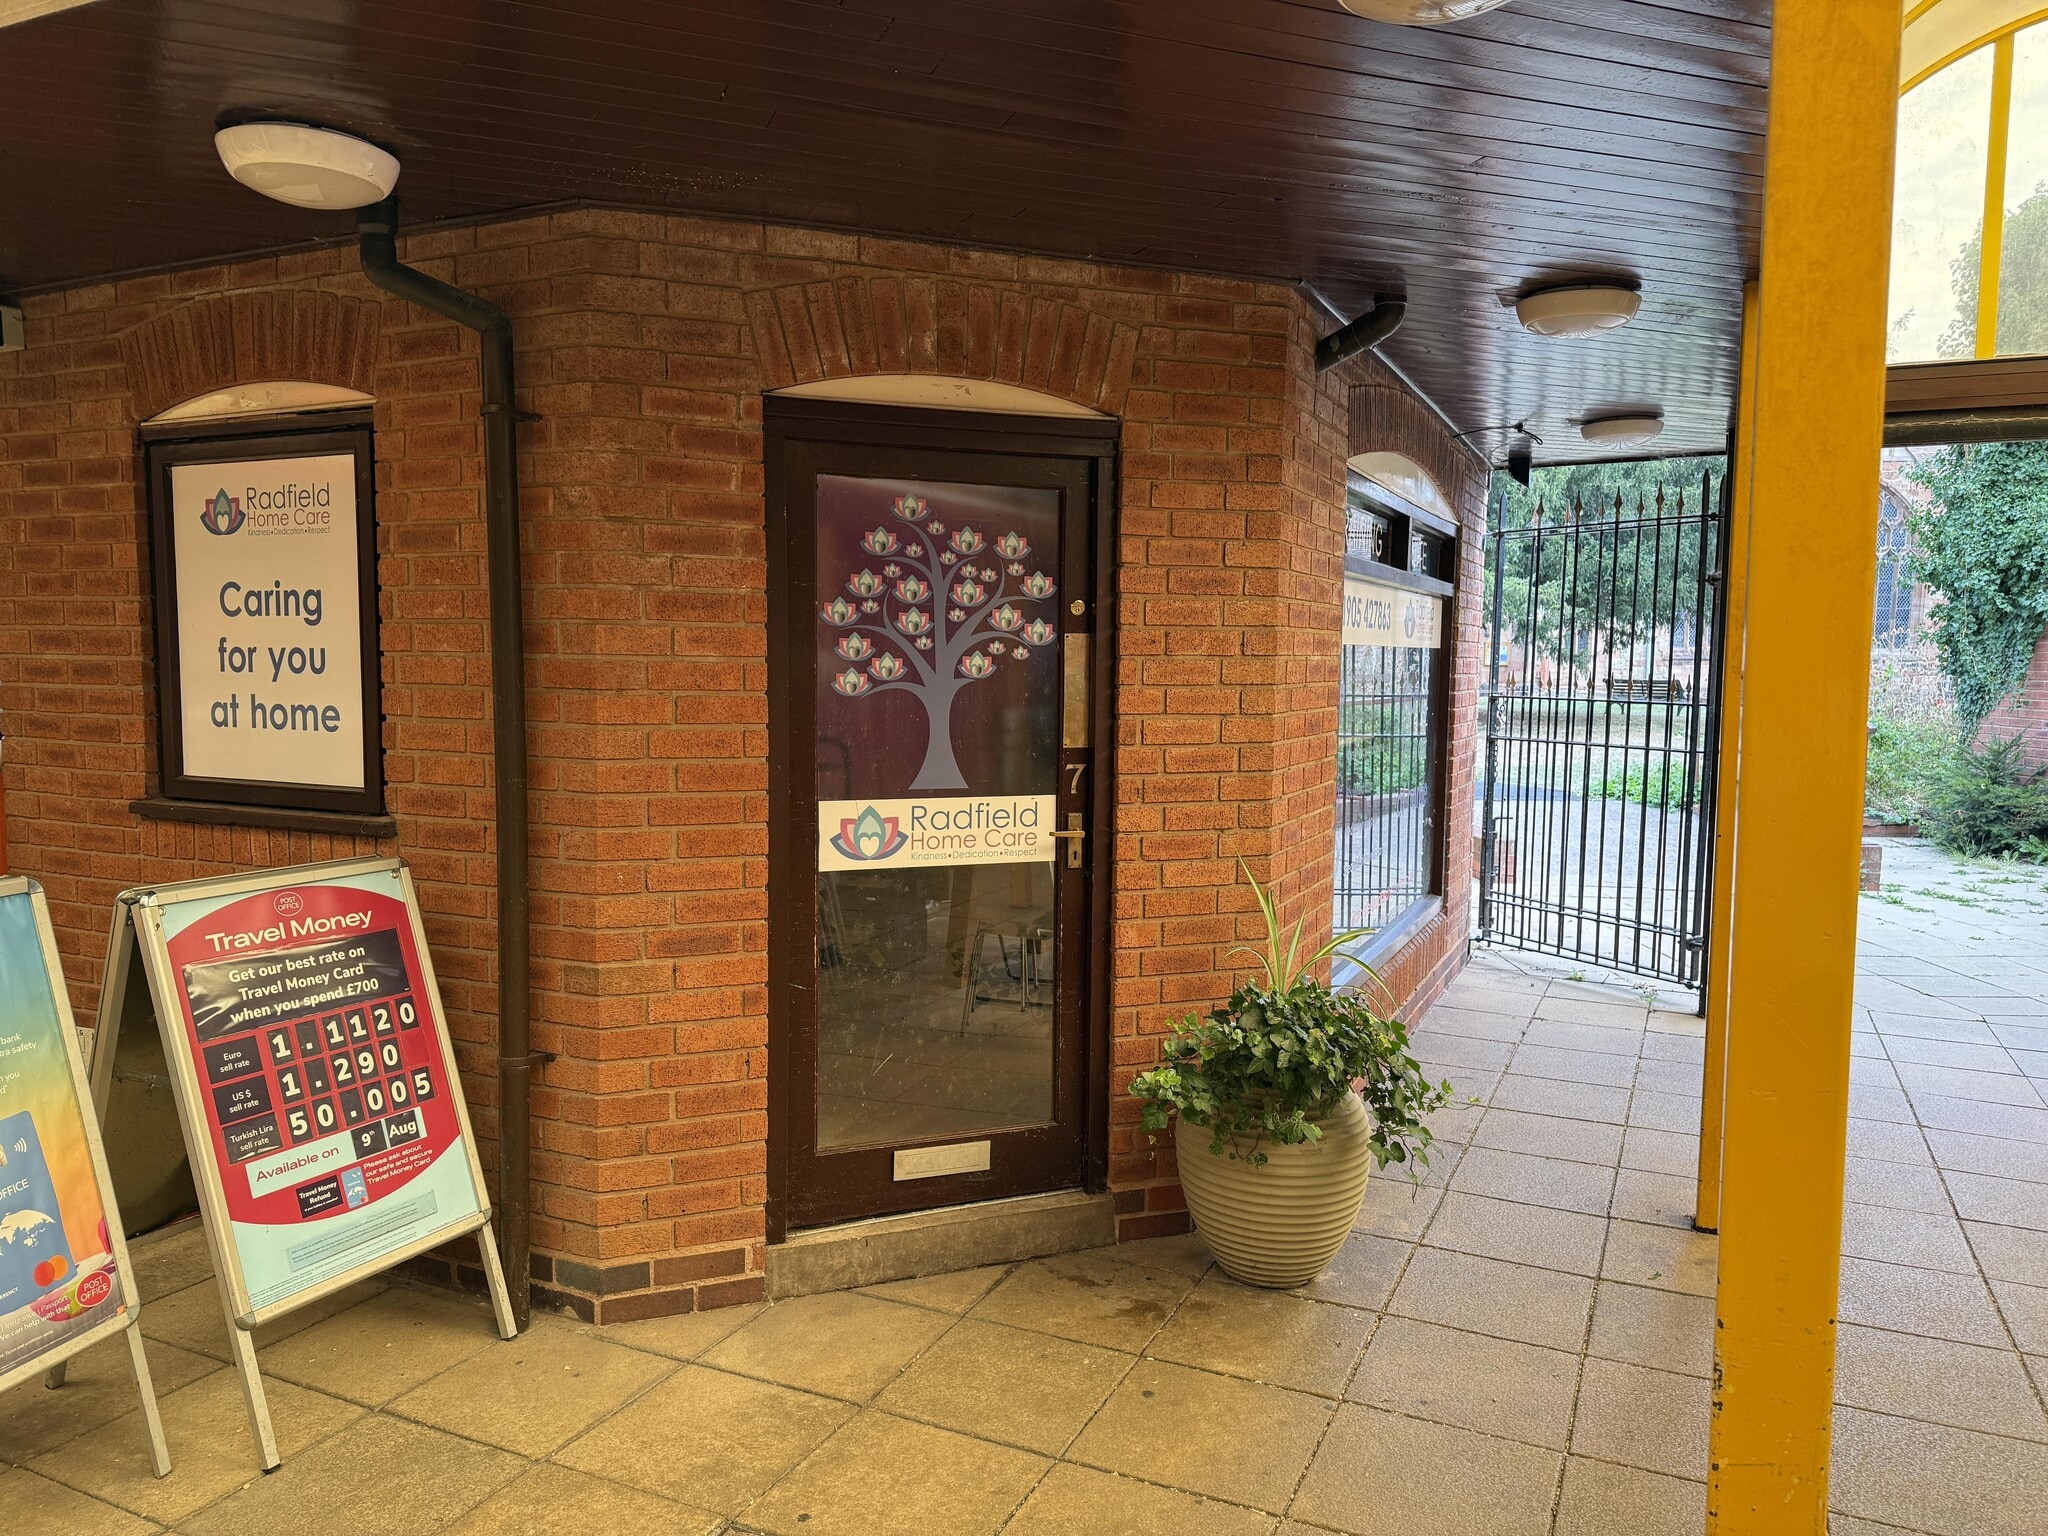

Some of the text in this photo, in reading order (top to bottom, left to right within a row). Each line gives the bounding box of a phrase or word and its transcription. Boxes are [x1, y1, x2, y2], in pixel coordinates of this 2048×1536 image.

[246, 482, 330, 510] Radfield
[247, 508, 330, 528] Home Care
[219, 580, 322, 626] Caring
[1364, 598, 1391, 630] 427863
[218, 637, 326, 682] for you
[210, 694, 340, 732] at home
[1064, 764, 1087, 795] 7
[910, 801, 1039, 832] Radfield
[910, 829, 1038, 851] Home Care
[278, 902, 300, 911] OFFICE
[280, 896, 296, 904] POST
[205, 910, 373, 951] Travel Money
[229, 946, 365, 983] Get our best rate on
[238, 963, 364, 1002] Travel Money Card
[229, 978, 379, 1025] when you spend £700
[0, 1032, 21, 1045] bank
[12, 1041, 37, 1054] safety
[220, 1059, 250, 1073] sell rate
[223, 1051, 242, 1061] Euro
[5, 1071, 20, 1082] you
[229, 1099, 259, 1113] sell rate
[232, 1092, 244, 1102] US
[246, 1089, 252, 1098] $
[230, 1124, 274, 1144] Turkish Lira
[240, 1137, 269, 1151] sell rate
[361, 1120, 417, 1146] 9th Aug
[255, 1147, 339, 1182] Available on
[363, 1145, 422, 1170] Please ask about
[365, 1149, 433, 1177] our safe and secure
[367, 1173, 389, 1185] Travel
[390, 1164, 413, 1177] Money
[414, 1157, 431, 1167] Card
[299, 1188, 318, 1199] Travel
[318, 1182, 337, 1193] Money
[309, 1192, 331, 1204] Refund
[80, 1282, 109, 1302] OFFICE
[83, 1276, 103, 1291] POST
[4, 1295, 69, 1329] Insurance Passport
[11, 1325, 24, 1336] can
[24, 1319, 40, 1332] help
[40, 1310, 55, 1322] with
[55, 1303, 71, 1314] that
